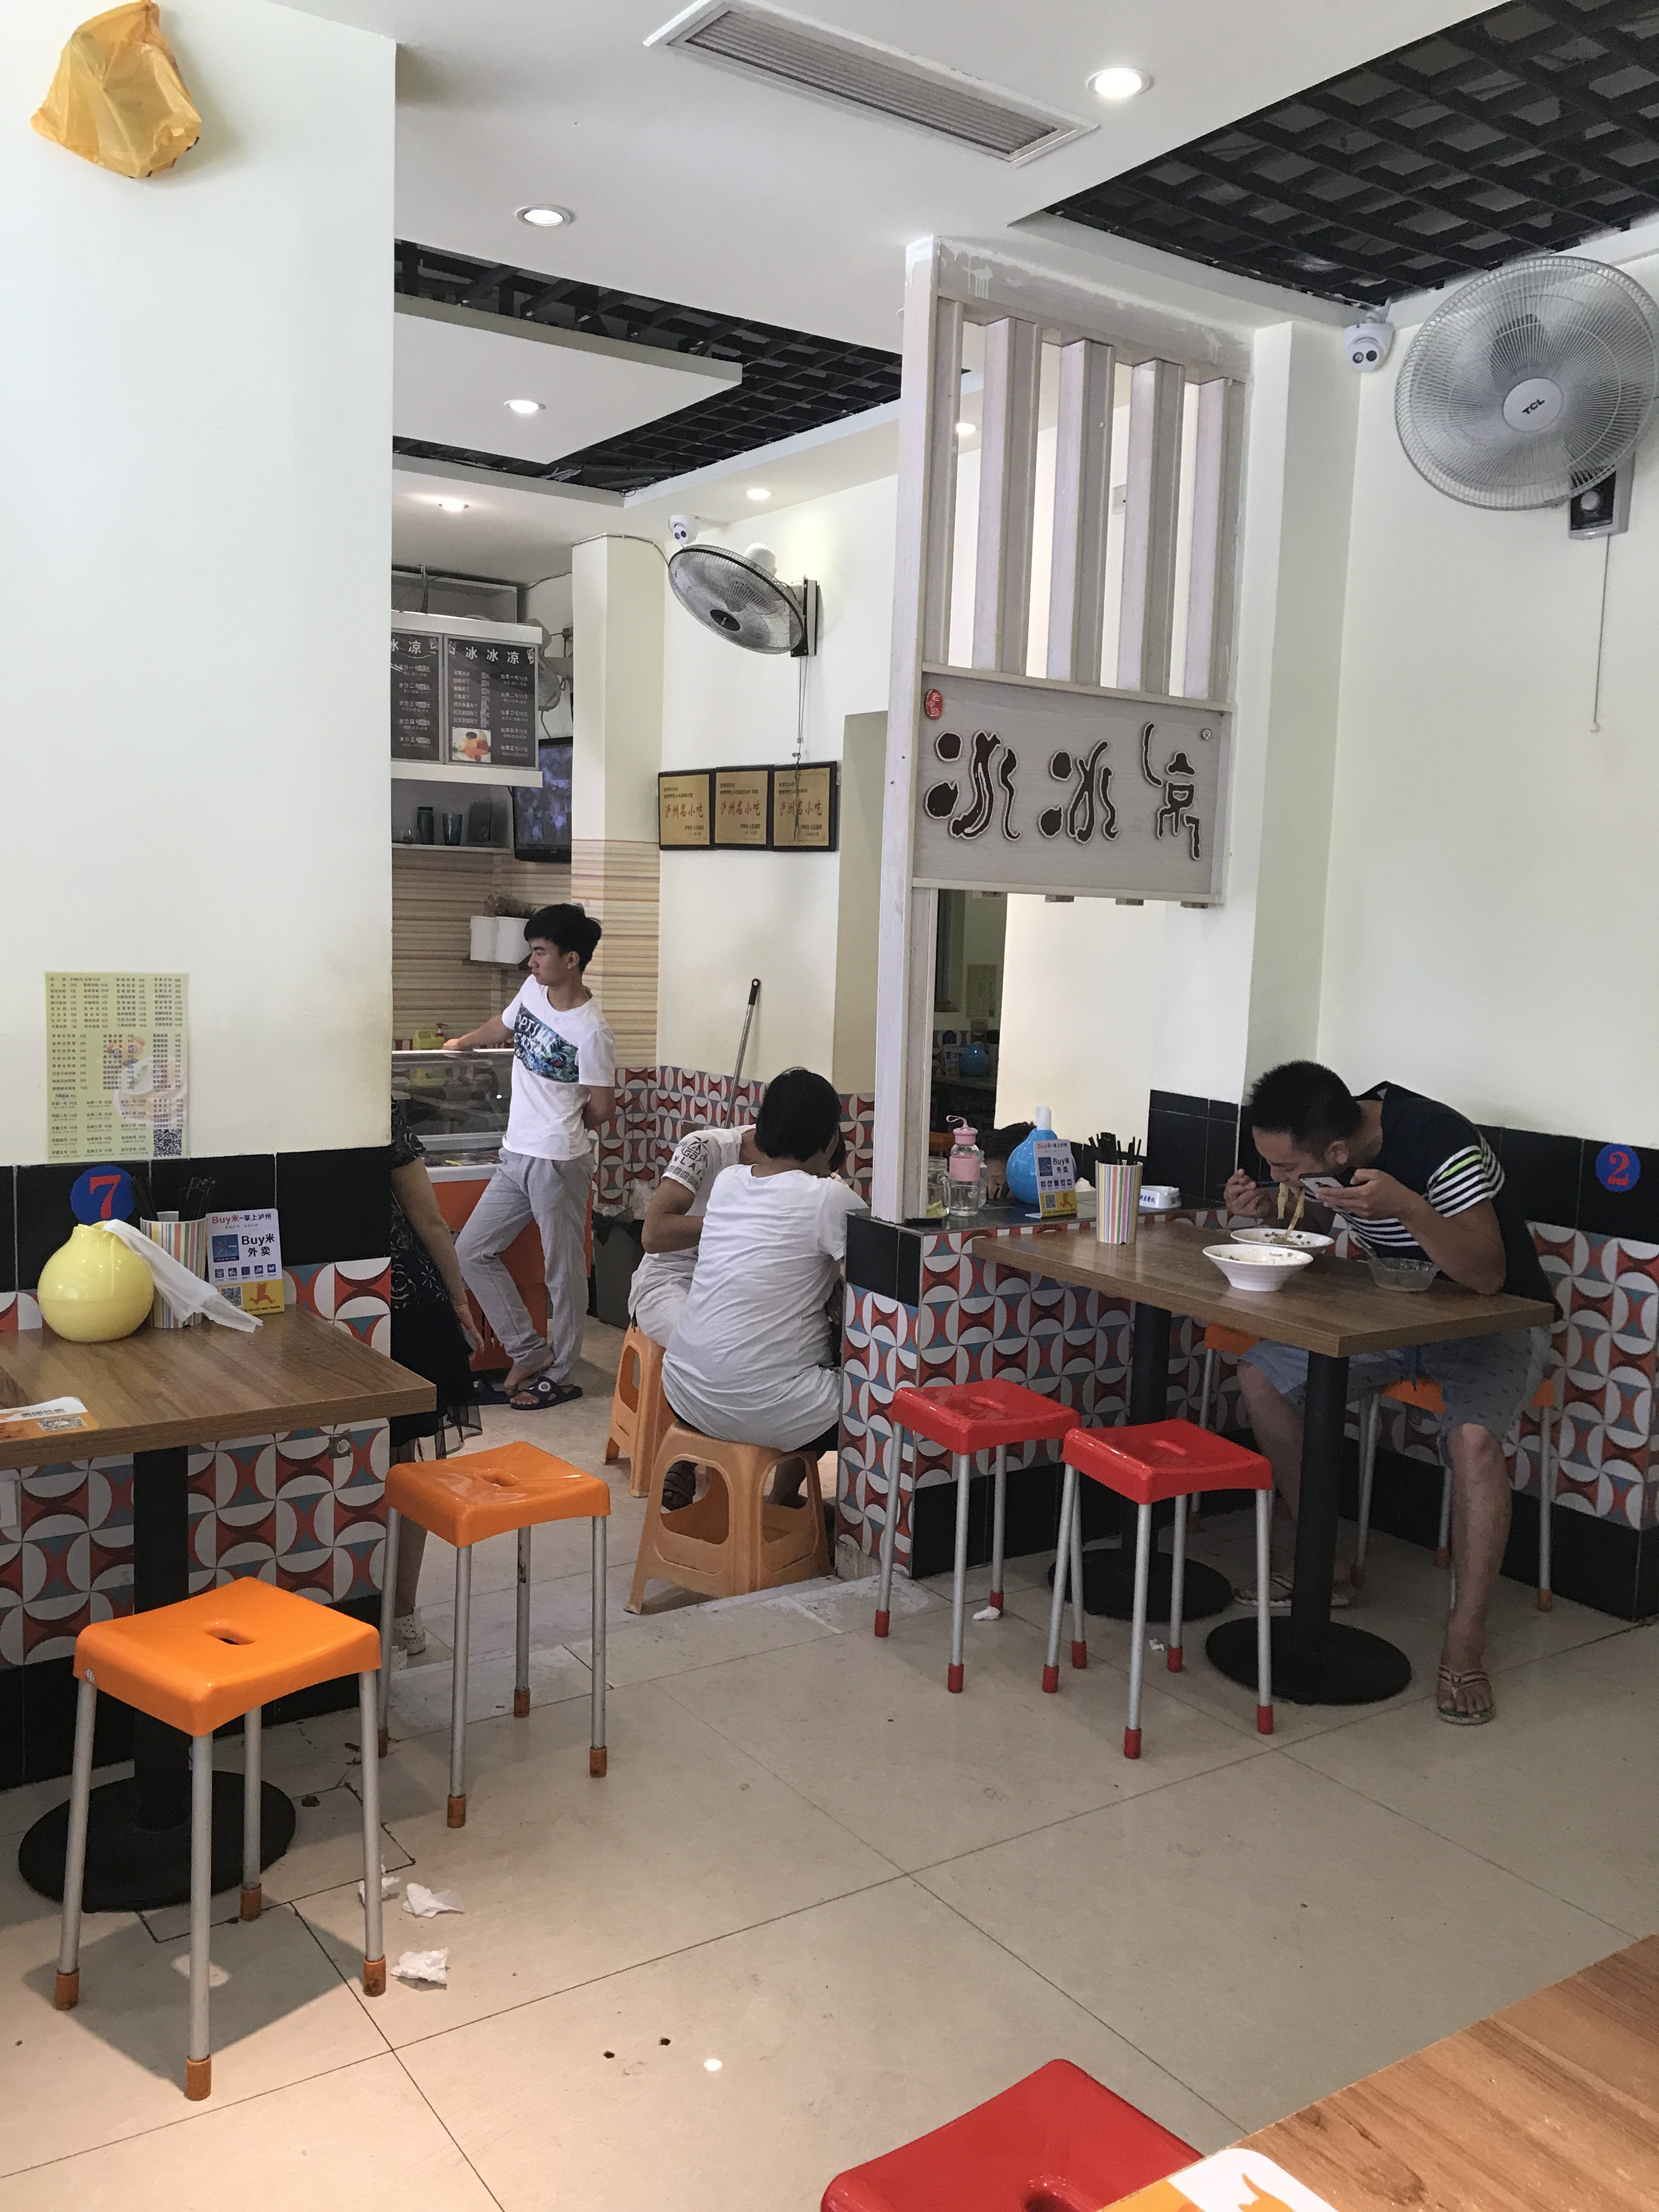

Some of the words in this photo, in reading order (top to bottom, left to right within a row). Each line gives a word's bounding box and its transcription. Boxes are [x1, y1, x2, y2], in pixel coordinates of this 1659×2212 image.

[1522, 399, 1545, 414] TCL
[1607, 1150, 1630, 1186] 2
[89, 1174, 122, 1219] 7
[241, 1233, 275, 1246] Buy米
[247, 1246, 271, 1257] 外卖
